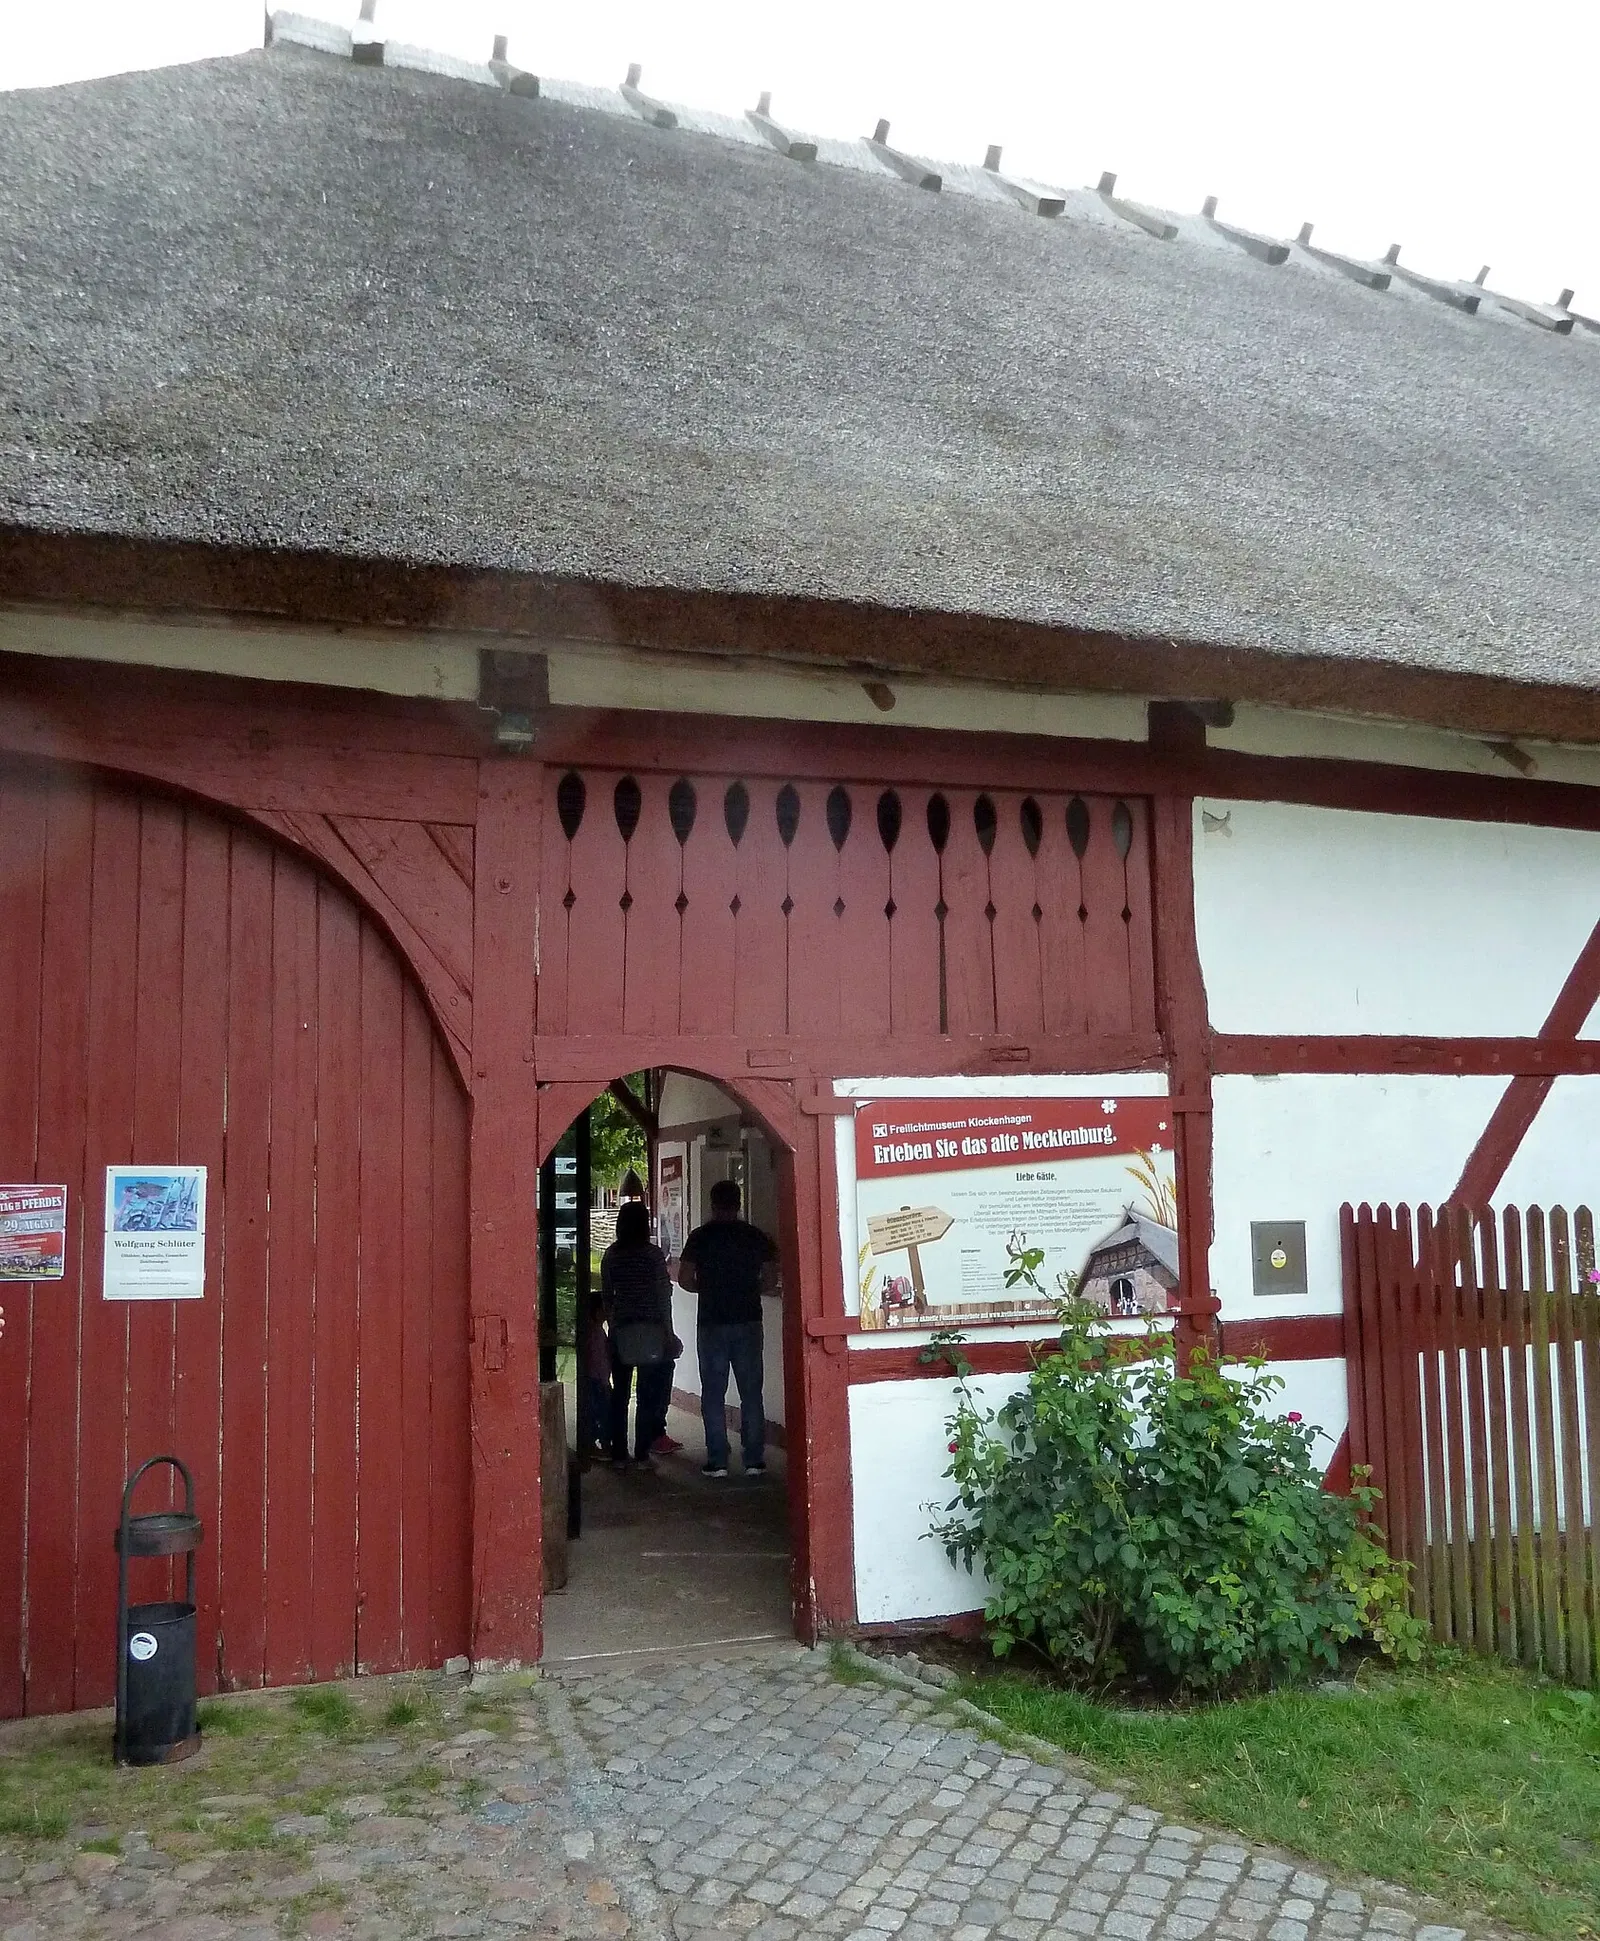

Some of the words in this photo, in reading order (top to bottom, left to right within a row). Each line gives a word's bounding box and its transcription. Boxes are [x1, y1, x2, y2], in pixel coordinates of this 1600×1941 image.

[889, 1120, 966, 1134] Freilichtmuseum
[968, 1114, 1032, 1127] Klockenhagen
[873, 1142, 933, 1164] Erleben
[936, 1139, 958, 1158] Sie
[962, 1137, 987, 1155] das
[991, 1134, 1019, 1153] alte
[1022, 1125, 1133, 1149] Mecklenburg.
[1016, 1173, 1035, 1181] Liebe
[1036, 1172, 1057, 1181] Gäste,
[22, 1197, 62, 1209] PFERDES
